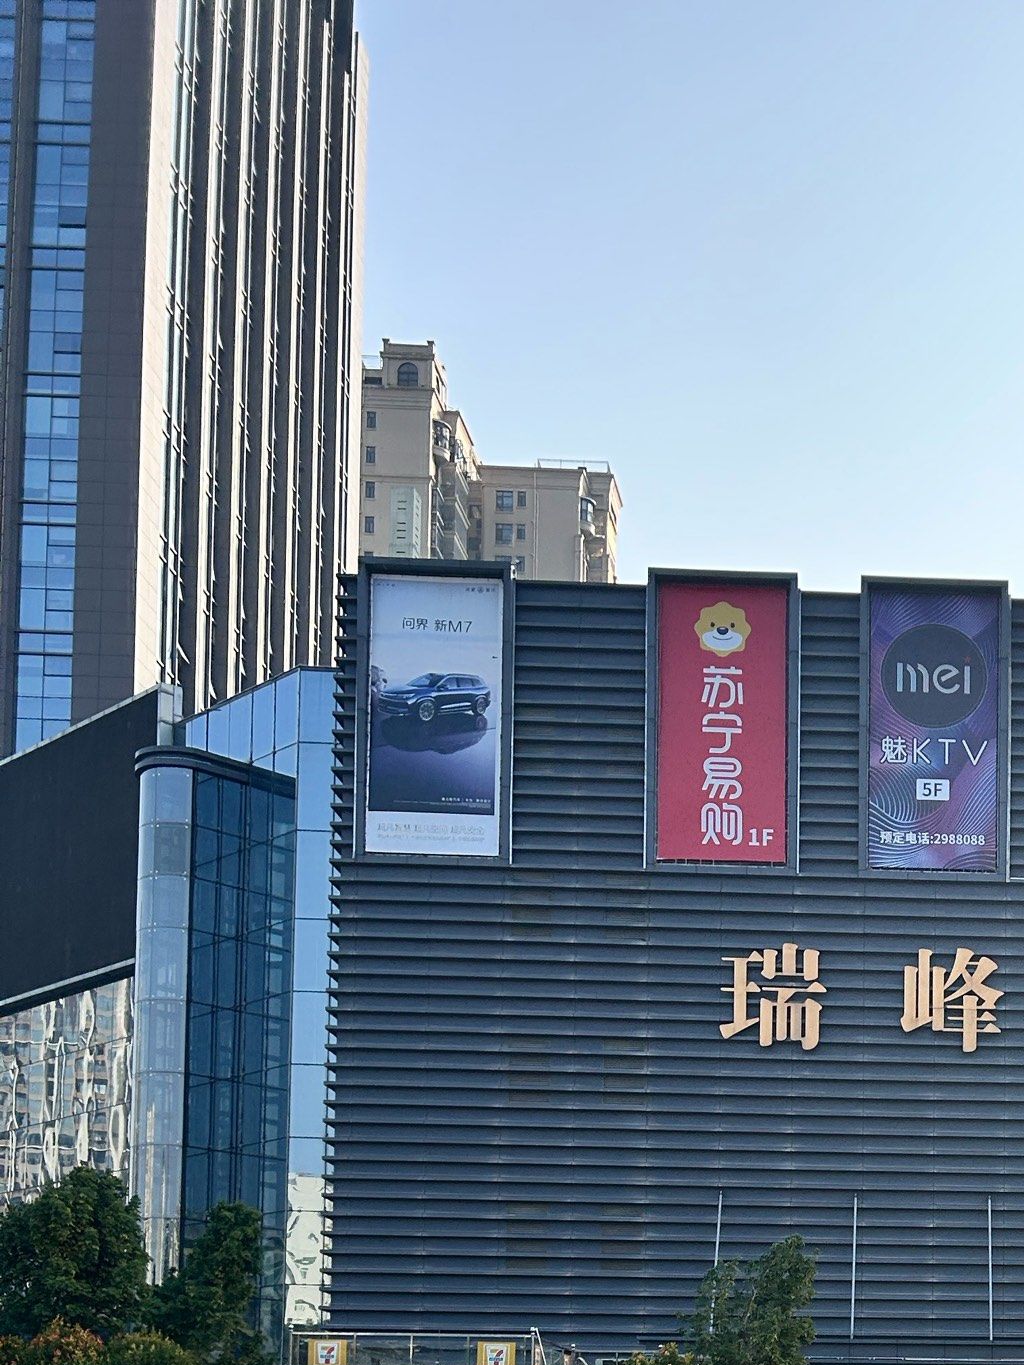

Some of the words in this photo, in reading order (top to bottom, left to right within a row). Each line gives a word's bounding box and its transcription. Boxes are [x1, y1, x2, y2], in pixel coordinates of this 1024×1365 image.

[402, 616, 428, 631] 问界
[434, 618, 473, 633] 新M7
[896, 655, 971, 695] mei
[700, 665, 744, 847] 苏宁易购
[922, 782, 943, 797] 5F
[748, 828, 774, 846] 1F
